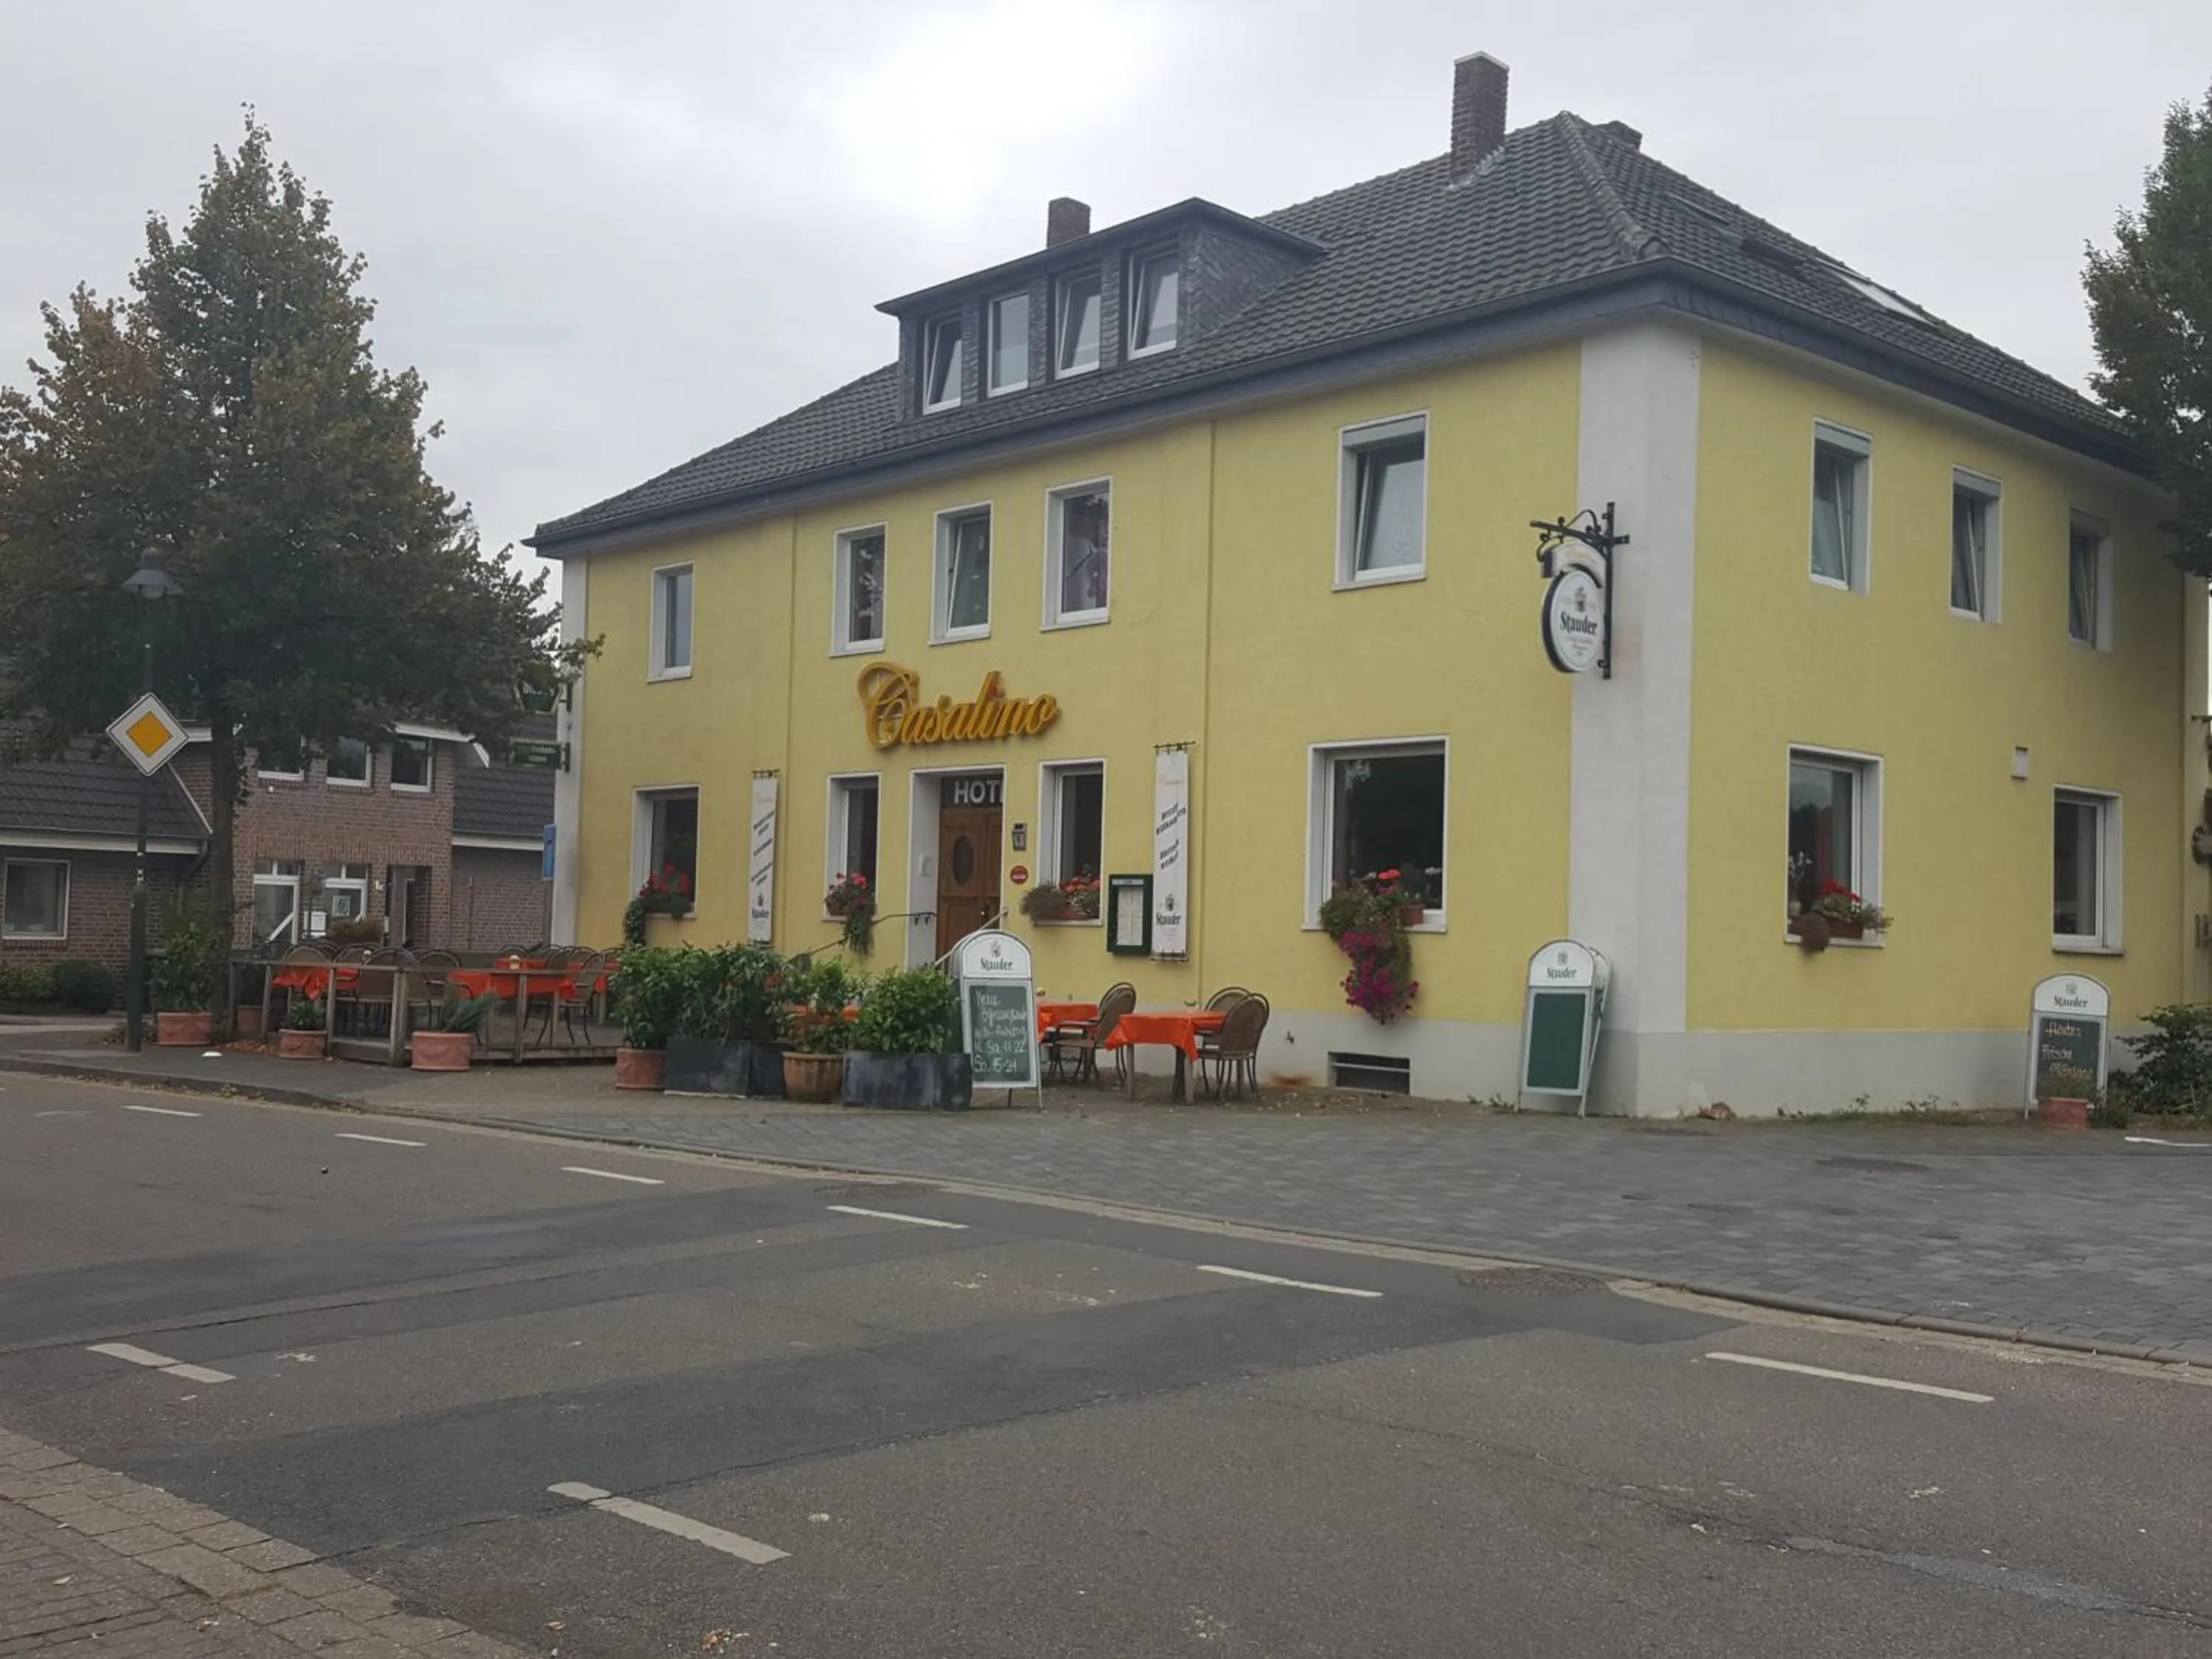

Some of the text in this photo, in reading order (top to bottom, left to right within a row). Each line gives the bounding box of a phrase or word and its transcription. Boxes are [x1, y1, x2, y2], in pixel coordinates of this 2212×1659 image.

[1559, 611, 1598, 636] Stauder
[858, 661, 1060, 750] Casalino
[954, 779, 1004, 804] HOT
[980, 956, 1013, 971] Stauder
[1546, 967, 1577, 979] Stauder
[2053, 996, 2088, 1008] Stauder
